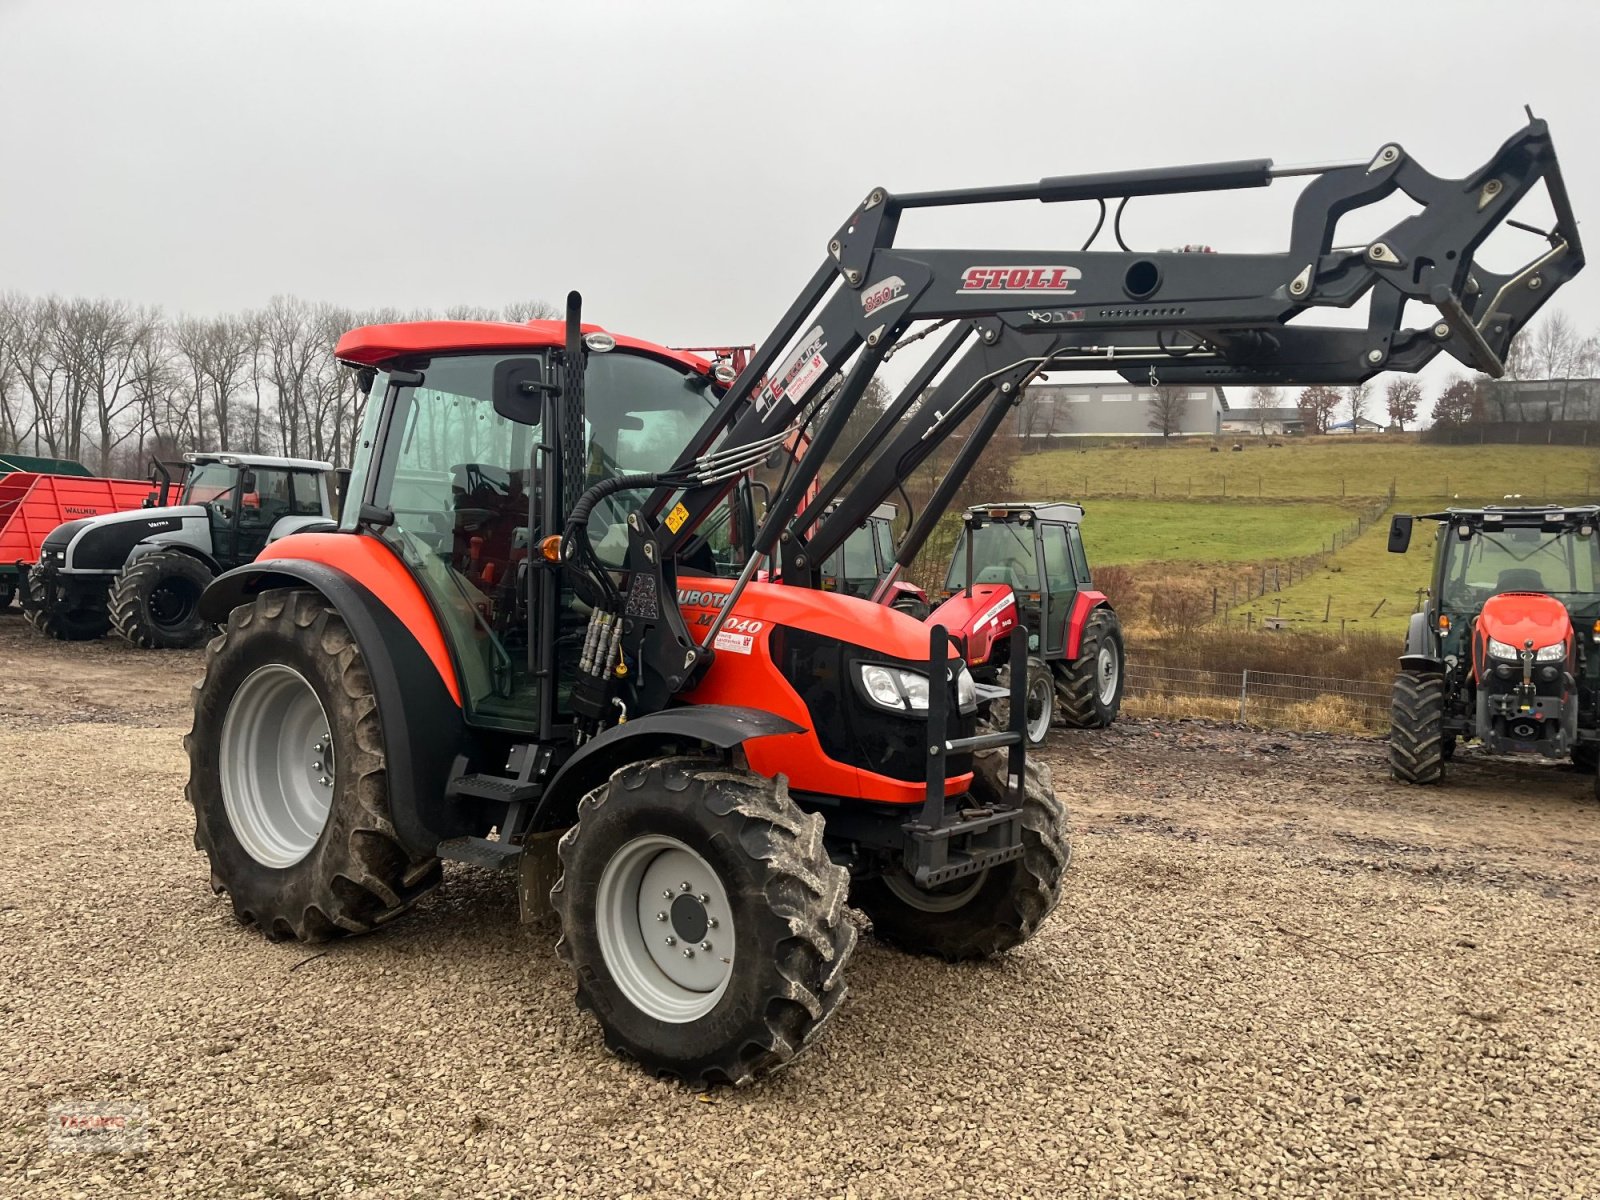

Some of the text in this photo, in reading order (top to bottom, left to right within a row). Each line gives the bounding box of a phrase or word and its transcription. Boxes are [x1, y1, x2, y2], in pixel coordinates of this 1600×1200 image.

[963, 269, 1069, 289] STOLL
[864, 287, 892, 313] 850
[65, 507, 98, 515] WALLNER
[695, 613, 763, 633] M040
